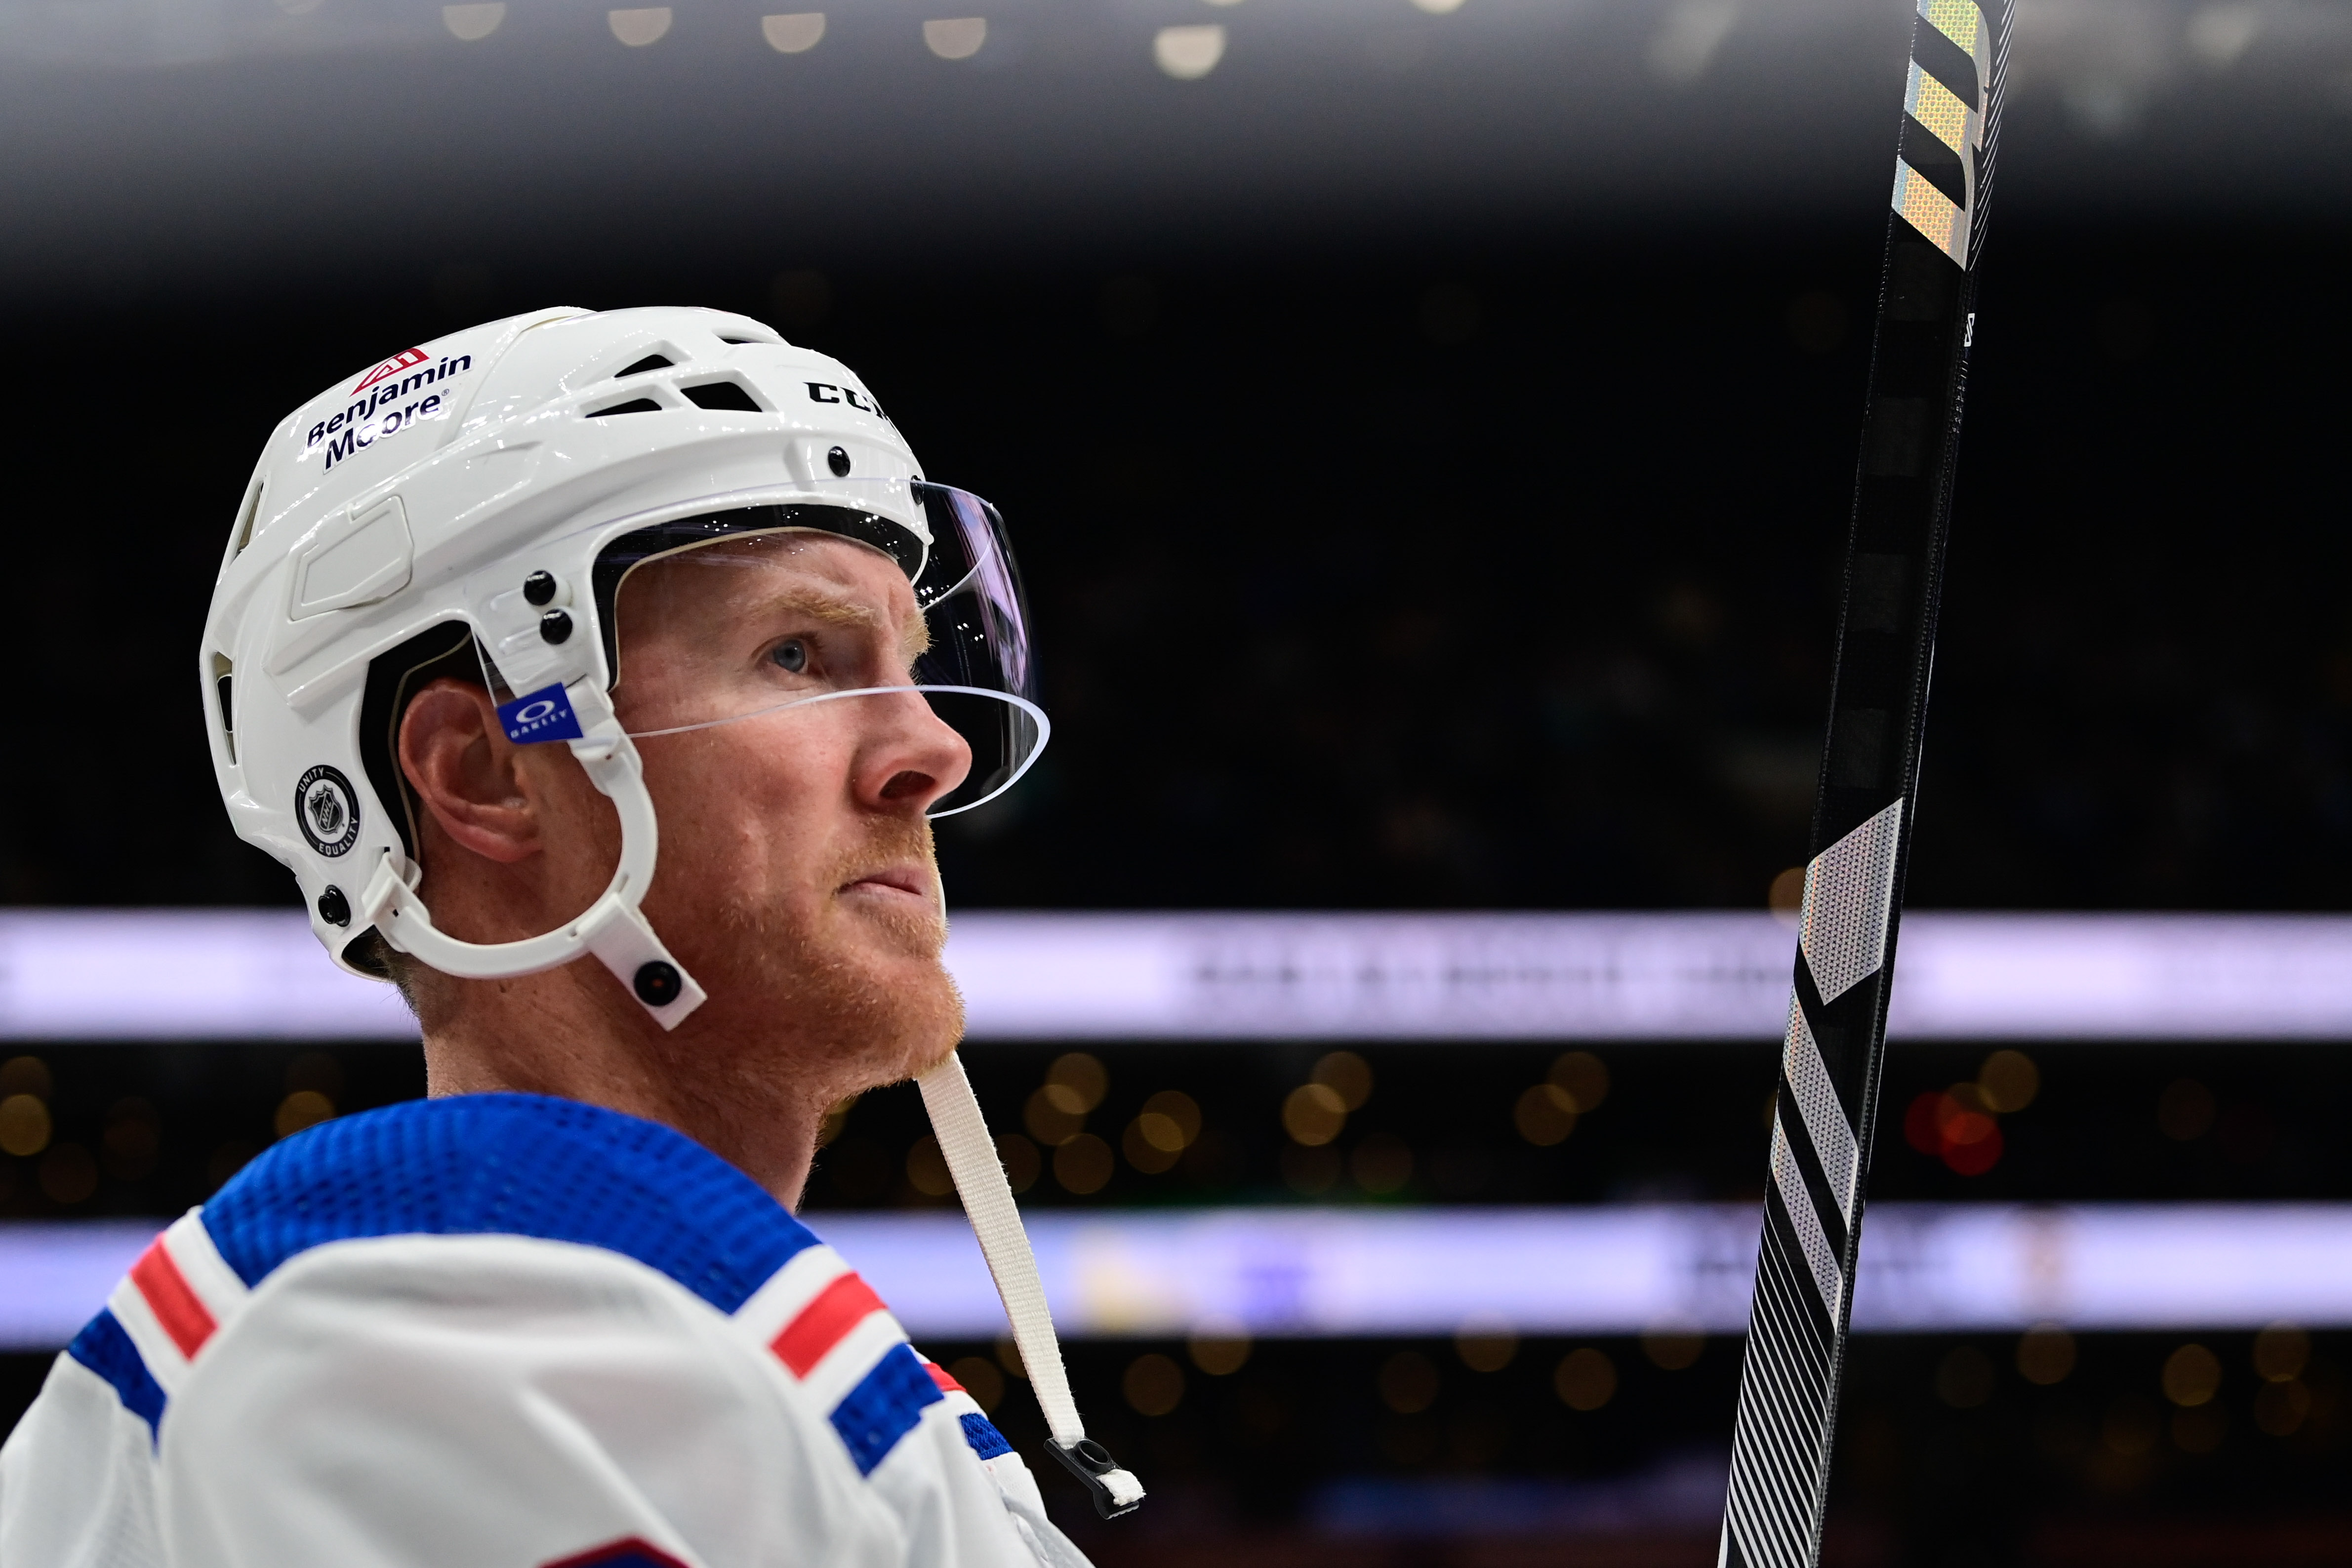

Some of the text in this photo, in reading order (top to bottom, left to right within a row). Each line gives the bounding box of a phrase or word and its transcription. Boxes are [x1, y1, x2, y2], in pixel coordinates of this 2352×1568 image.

[307, 355, 471, 448] Benjamin
[510, 709, 567, 739] OAKLEY
[298, 766, 324, 793] UNITY
[322, 799, 332, 827] NHL
[319, 816, 359, 856] EQUALITY
